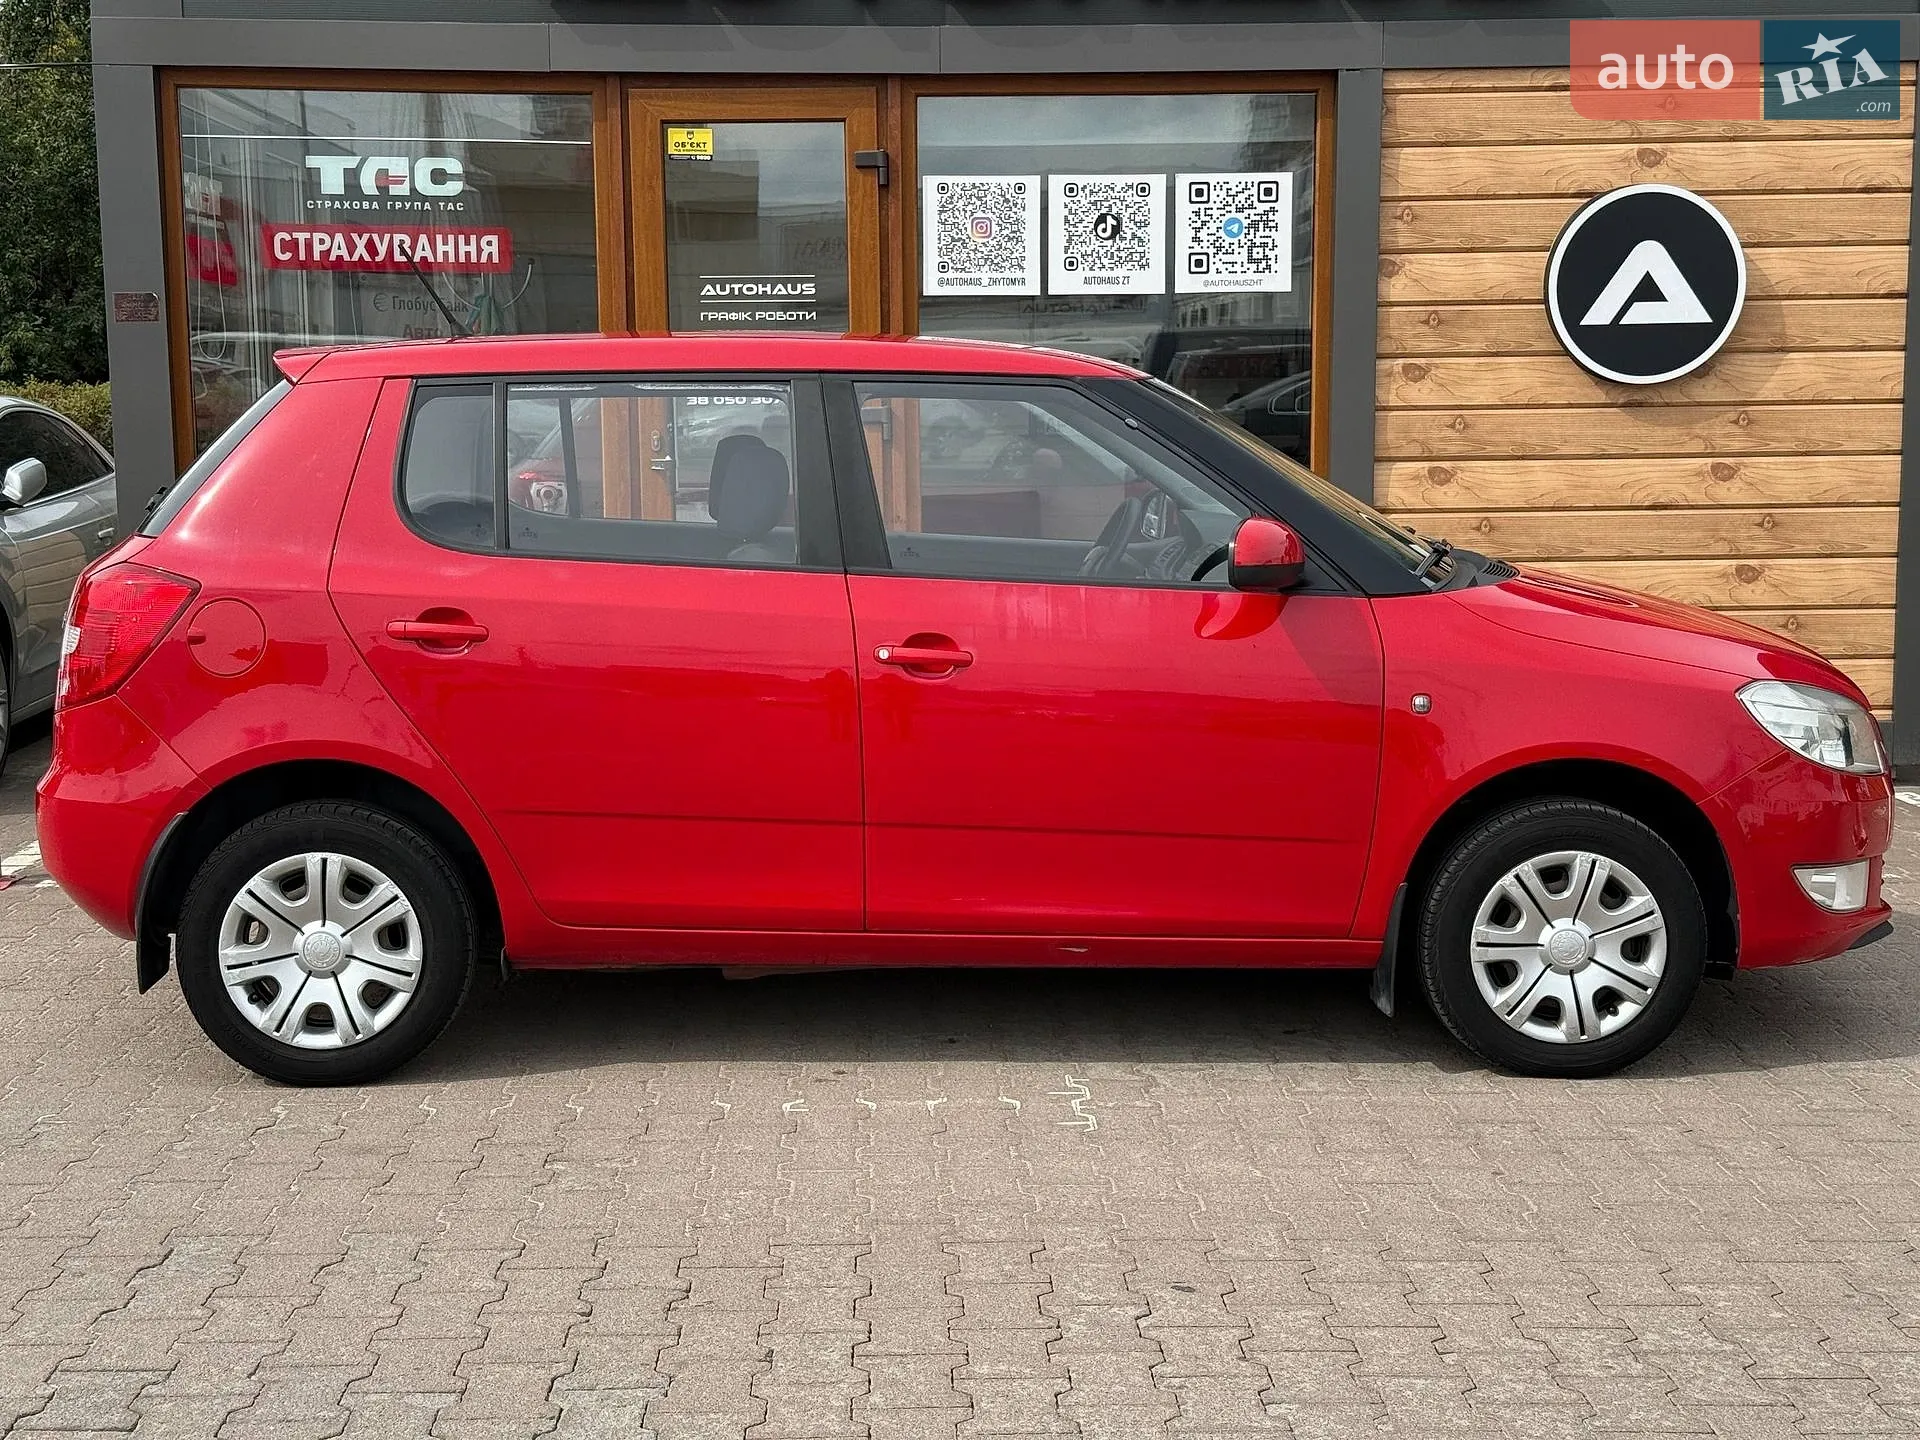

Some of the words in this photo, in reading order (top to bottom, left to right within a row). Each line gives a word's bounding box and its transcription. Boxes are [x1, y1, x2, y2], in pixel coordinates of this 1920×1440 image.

[306, 200, 380, 210] СТРАХОВА
[387, 201, 432, 211] ГРУПА
[438, 202, 465, 211] ТАС
[273, 231, 499, 264] СТРАХУВАННЯ
[937, 276, 1026, 287] @AUTOHAUS_ZHYTOMYR
[1083, 275, 1120, 285] AUTOHAUS
[700, 283, 816, 296] AUTOHAUS
[700, 311, 752, 321] ГРАФІК
[756, 311, 816, 321] РОБОТИ
